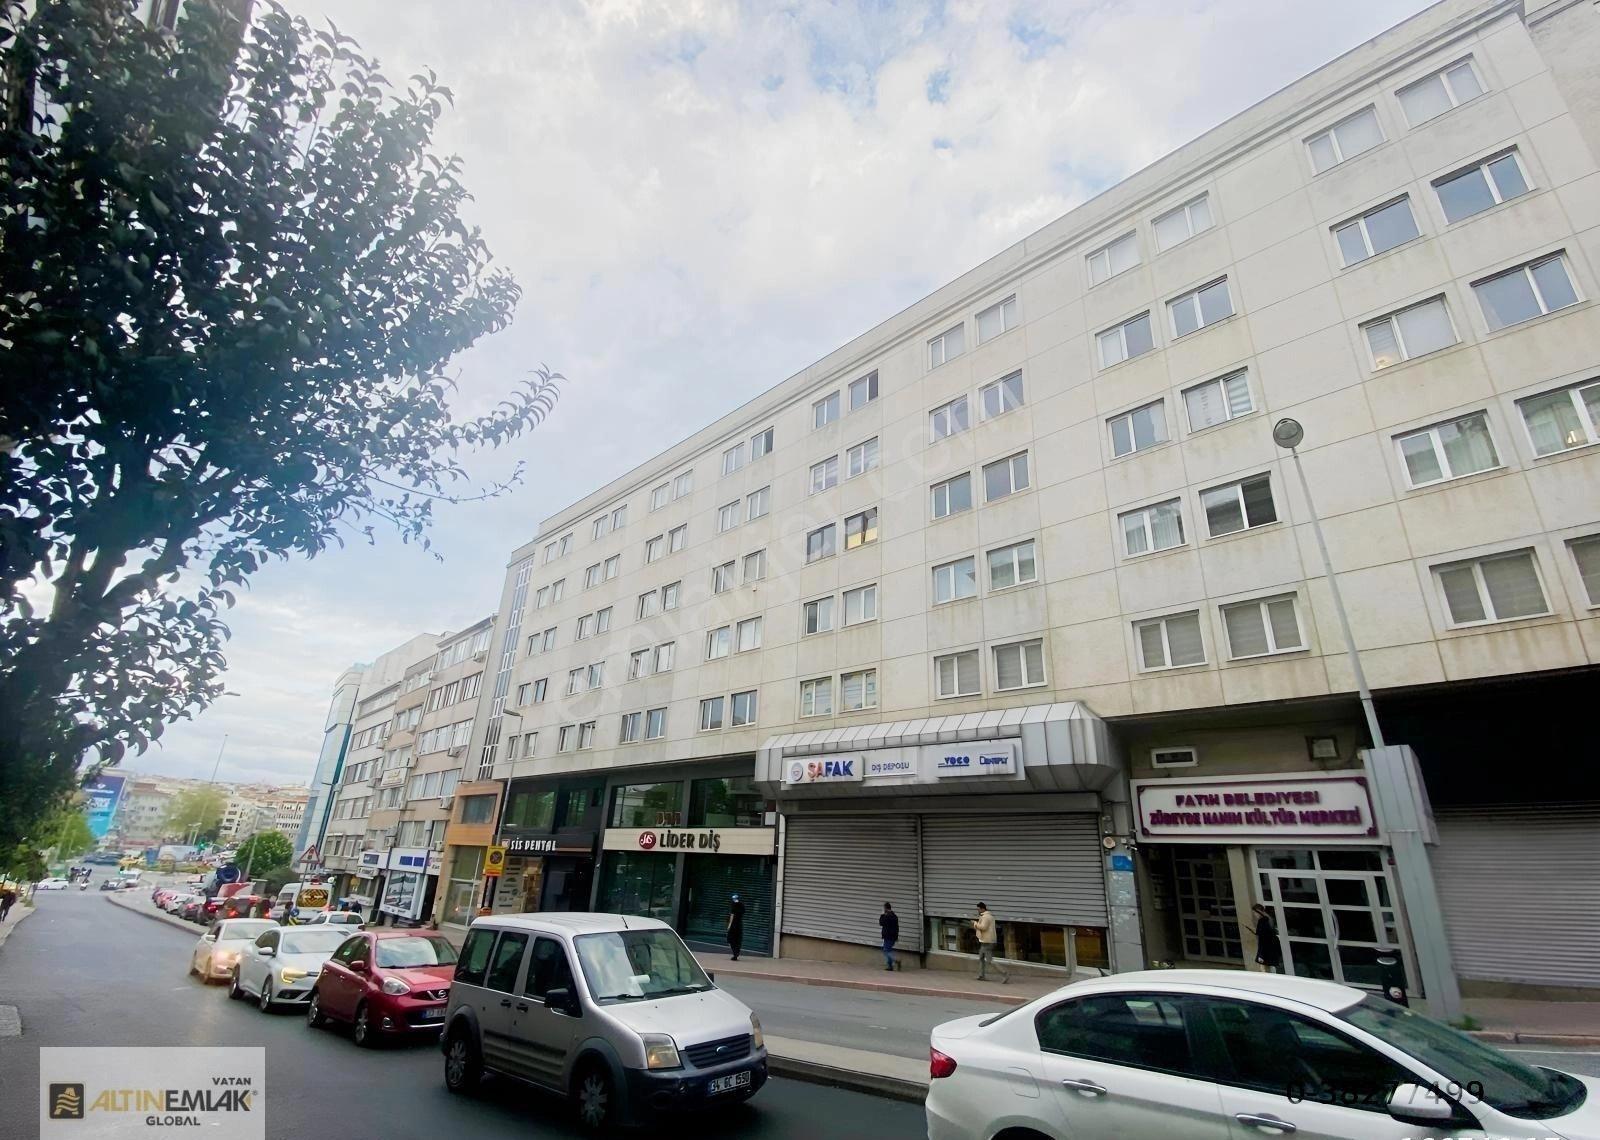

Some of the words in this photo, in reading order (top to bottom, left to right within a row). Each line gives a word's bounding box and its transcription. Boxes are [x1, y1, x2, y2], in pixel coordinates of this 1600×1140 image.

[808, 760, 853, 783] ŞAFAK
[1244, 807, 1298, 825] KÜLTÜR
[525, 840, 556, 851] DENTAL
[660, 829, 694, 848] LİDER
[699, 829, 721, 852] DİŞ
